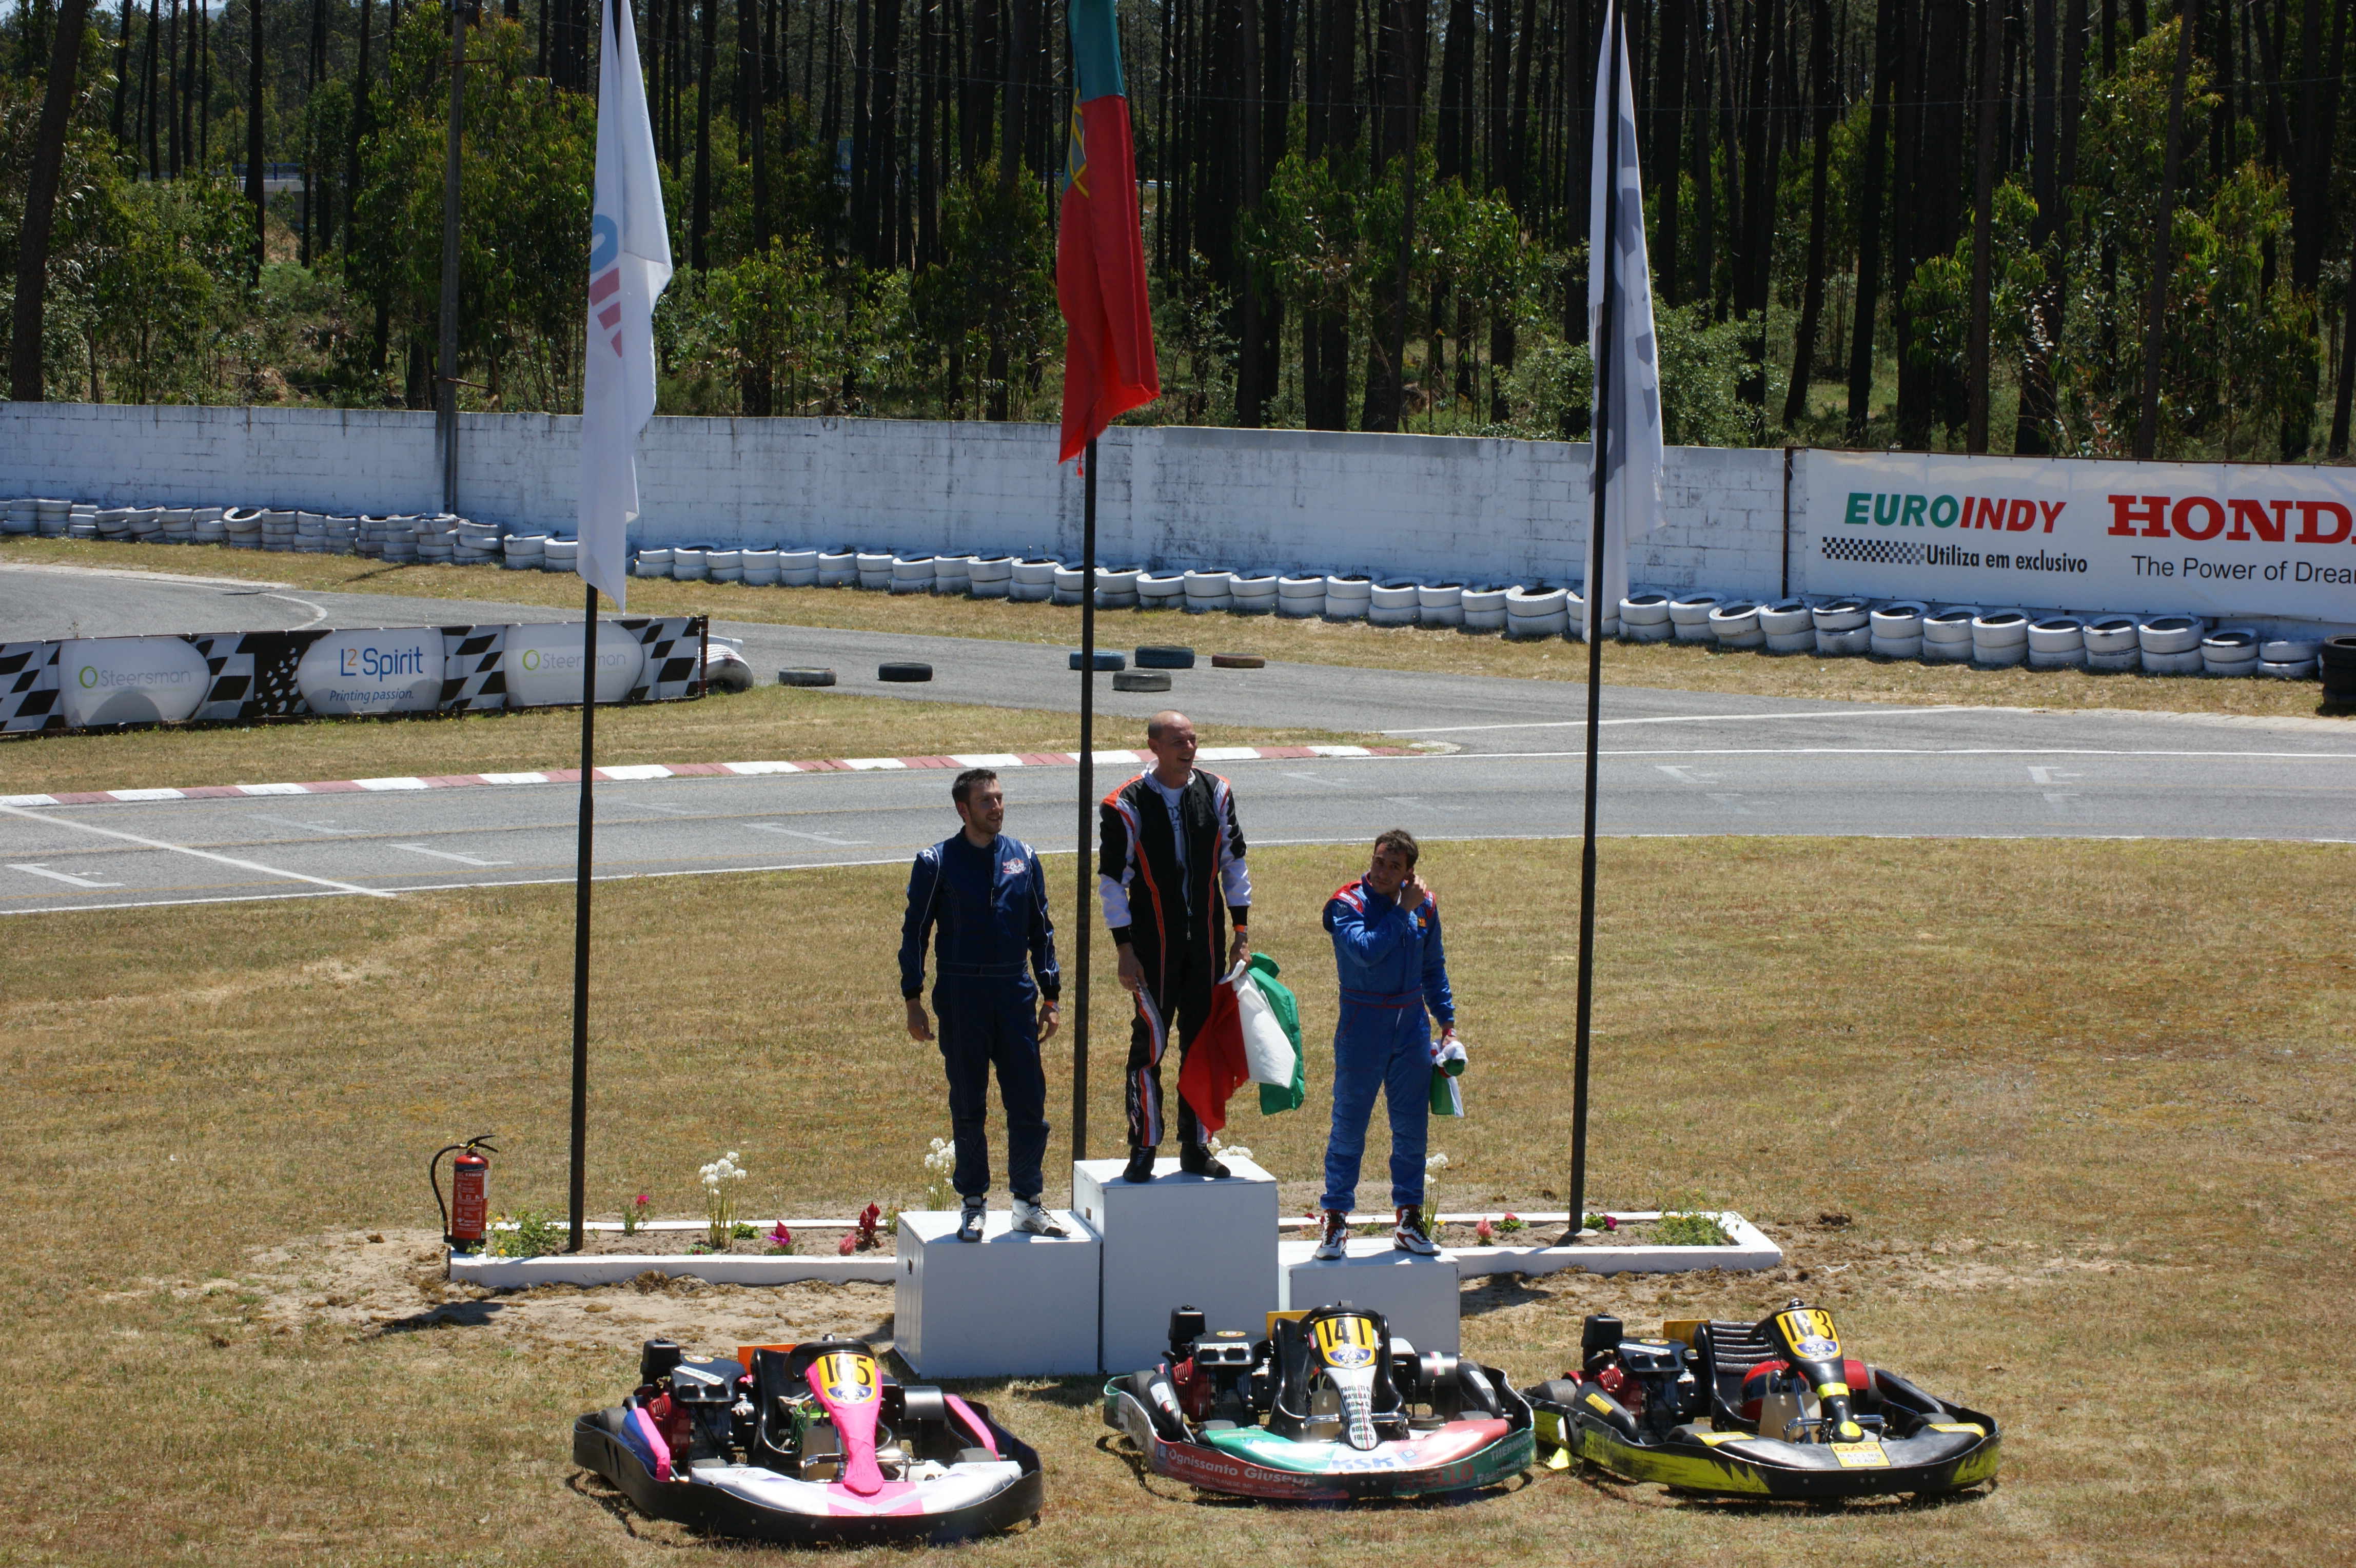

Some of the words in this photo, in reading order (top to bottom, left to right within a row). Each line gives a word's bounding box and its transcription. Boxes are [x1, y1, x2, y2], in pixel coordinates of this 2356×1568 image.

[1844, 493, 2067, 533] EUROINDY
[2108, 495, 2356, 545] HOND
[1927, 544, 1979, 567] Utiliza
[1986, 554, 2010, 569] em
[2016, 549, 2088, 573] exclusivo
[2131, 555, 2174, 576] The
[2183, 558, 2256, 580] Power
[2264, 561, 2288, 581] of
[2295, 562, 2356, 584] Drea
[363, 646, 423, 682] Spirit
[542, 653, 626, 669] Steerman
[101, 670, 191, 687] Steersman
[329, 689, 370, 704] Printing
[372, 688, 414, 703] passion.
[1324, 1318, 1366, 1347] 141
[1783, 1310, 1834, 1342] 103
[1169, 1448, 1238, 1477] Ognissanto
[1244, 1466, 1318, 1487] Giusepp
